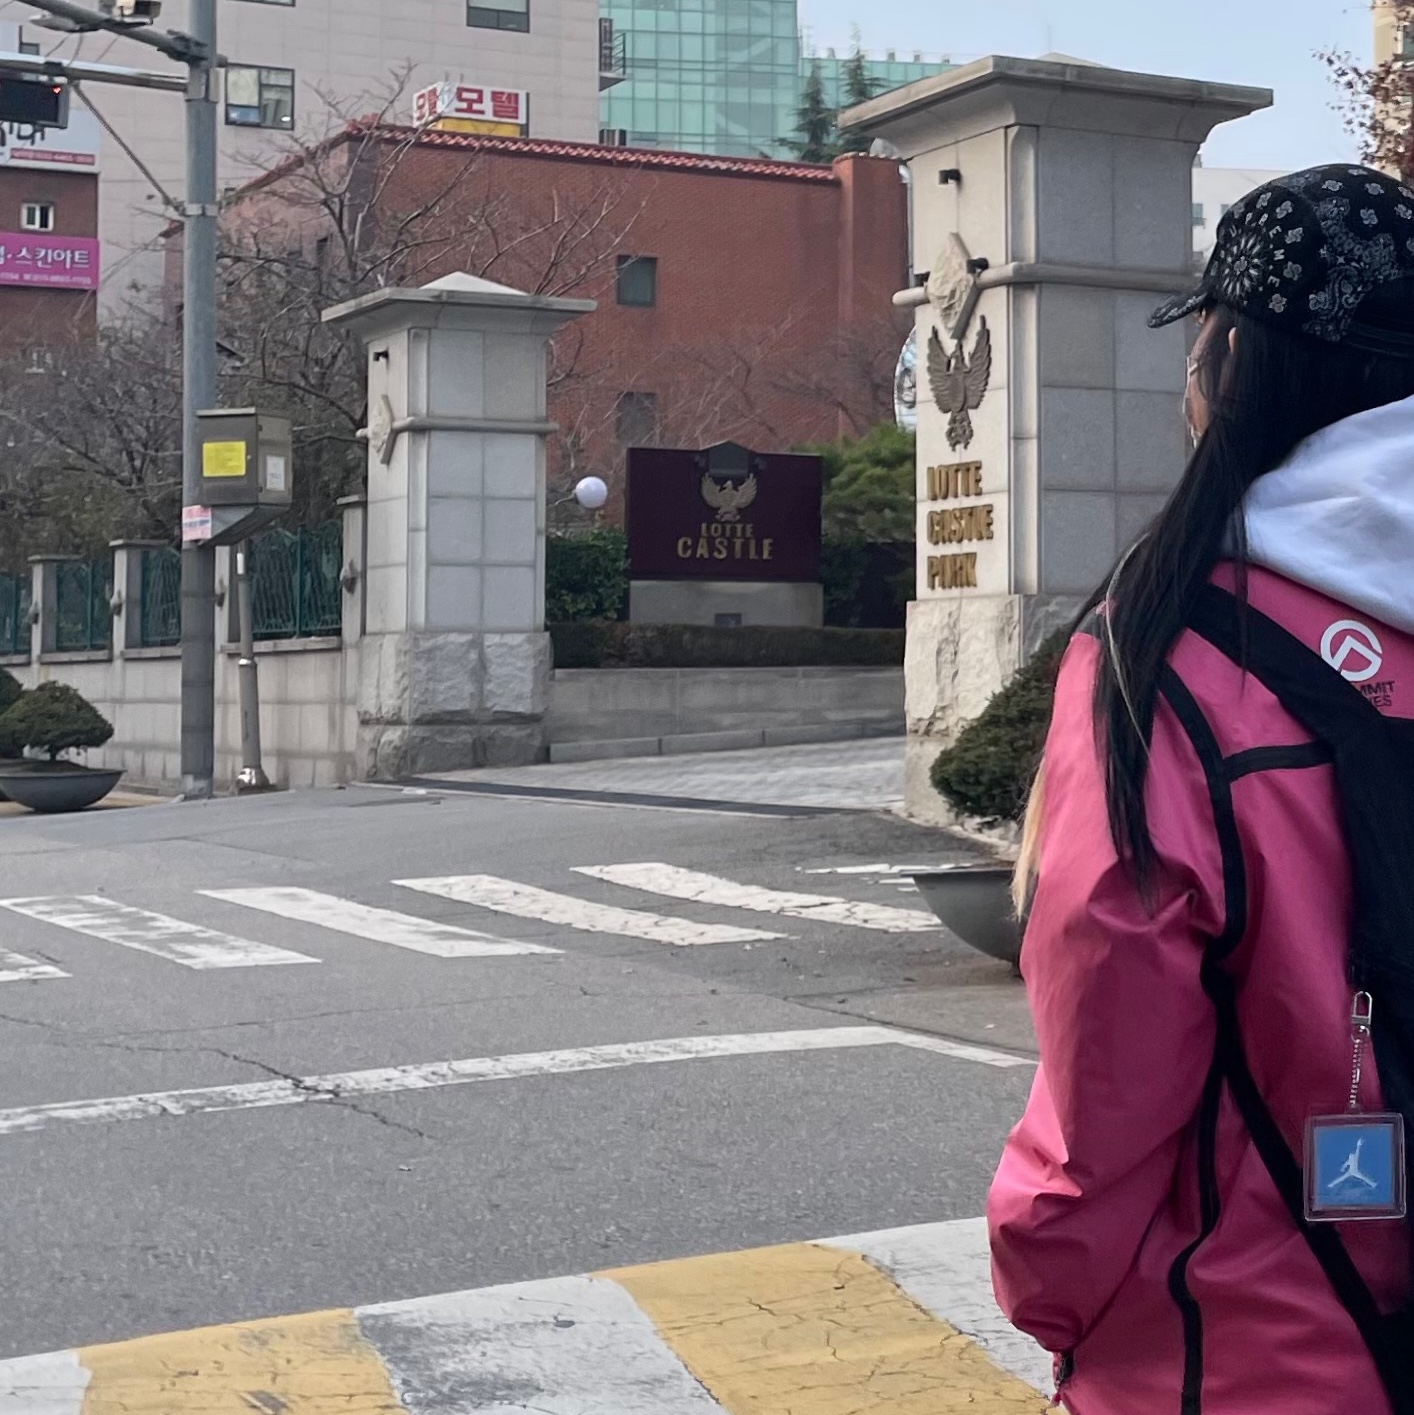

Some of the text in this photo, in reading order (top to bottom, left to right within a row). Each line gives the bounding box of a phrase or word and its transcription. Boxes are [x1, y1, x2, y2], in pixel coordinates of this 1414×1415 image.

[454, 86, 520, 121] 모텔
[1220, 212, 1285, 288] UPREME
[926, 460, 983, 501] LOTTE
[700, 522, 754, 538] LOTTE
[926, 503, 994, 546] CASTLE
[676, 536, 774, 560] CASTLE
[926, 551, 978, 591] PARK
